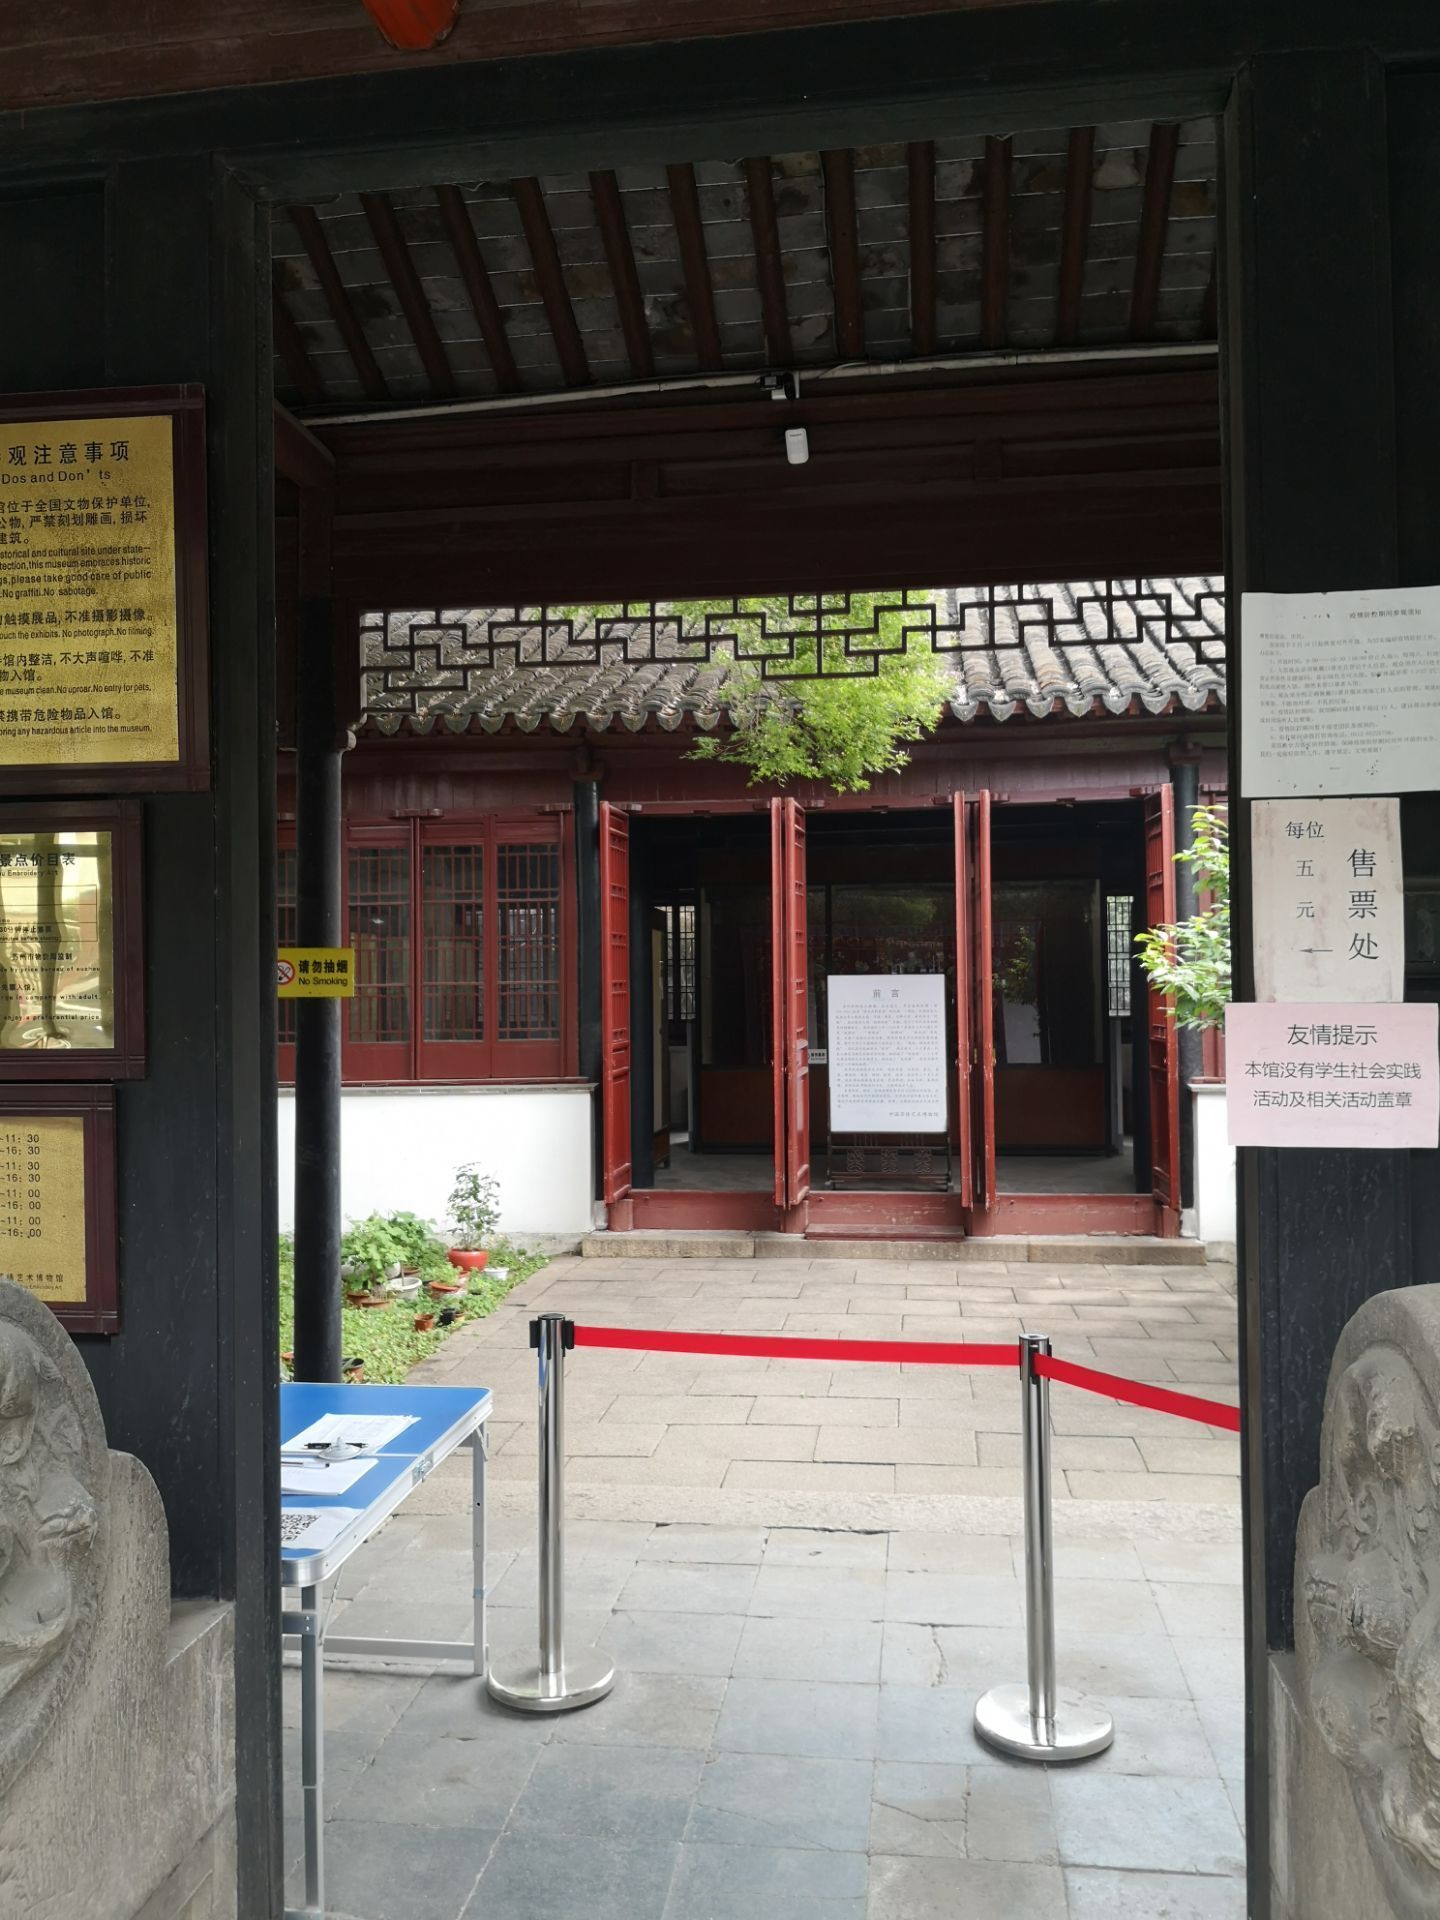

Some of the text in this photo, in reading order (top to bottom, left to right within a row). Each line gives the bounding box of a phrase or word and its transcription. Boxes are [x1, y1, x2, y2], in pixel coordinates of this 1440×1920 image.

[0, 440, 130, 466] 观注意事项
[1, 473, 27, 485] Dos
[30, 471, 54, 483] and
[31, 548, 47, 558] and
[48, 547, 80, 558] cultural
[80, 546, 96, 556] site
[97, 545, 121, 555] under
[45, 560, 79, 569] museum
[79, 558, 119, 568] embraces
[121, 556, 151, 566] historic
[43, 573, 63, 584] take
[65, 572, 88, 584] good
[90, 572, 110, 581] care
[112, 570, 122, 580] of
[123, 569, 152, 582] public
[0, 608, 153, 626] 触摸展品，不准摄影摄像。
[18, 630, 30, 639] the
[30, 629, 61, 639] exhibits.
[62, 628, 73, 639] No
[0, 650, 155, 667] 馆内整洁，不大声喧哗，不准
[5, 686, 35, 696] museum
[104, 683, 121, 694] entry
[18, 728, 31, 737] any
[31, 726, 69, 736] hazardous
[69, 725, 92, 735] article
[92, 725, 107, 734] into
[107, 725, 119, 734] the
[1284, 820, 1325, 840] 每位
[0, 852, 76, 867] 景点价目表
[1346, 848, 1380, 961] 售票处
[298, 959, 349, 974] 请勿抽烟
[298, 976, 349, 987] No Smoking
[1287, 1023, 1378, 1046] 友情提示
[1244, 1060, 1422, 1080] 本馆没有学生社会实践
[1253, 1090, 1413, 1109] 活动及相关活动盖章
